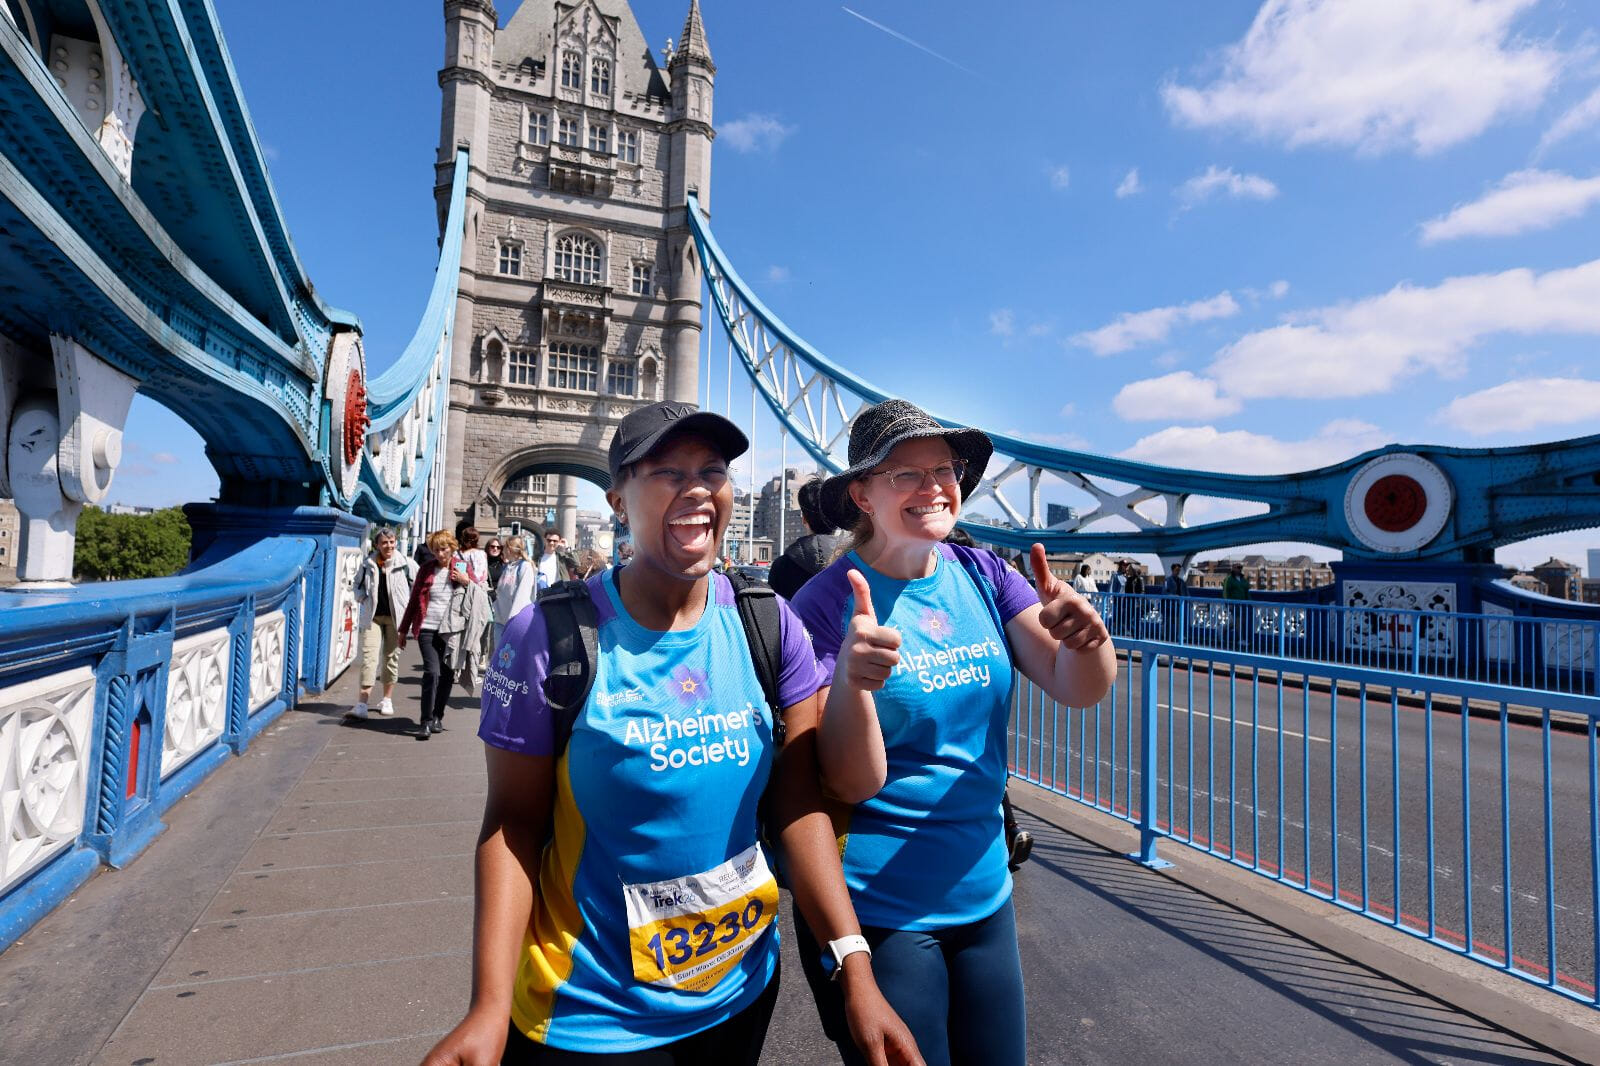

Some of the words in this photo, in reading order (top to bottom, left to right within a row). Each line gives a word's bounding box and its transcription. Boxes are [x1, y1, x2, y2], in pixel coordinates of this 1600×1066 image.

[897, 636, 1000, 675] Alzheimer's
[918, 663, 991, 693] Society
[624, 702, 762, 746] Alzheimer's
[650, 736, 750, 772] Society
[647, 898, 764, 970] 13230
